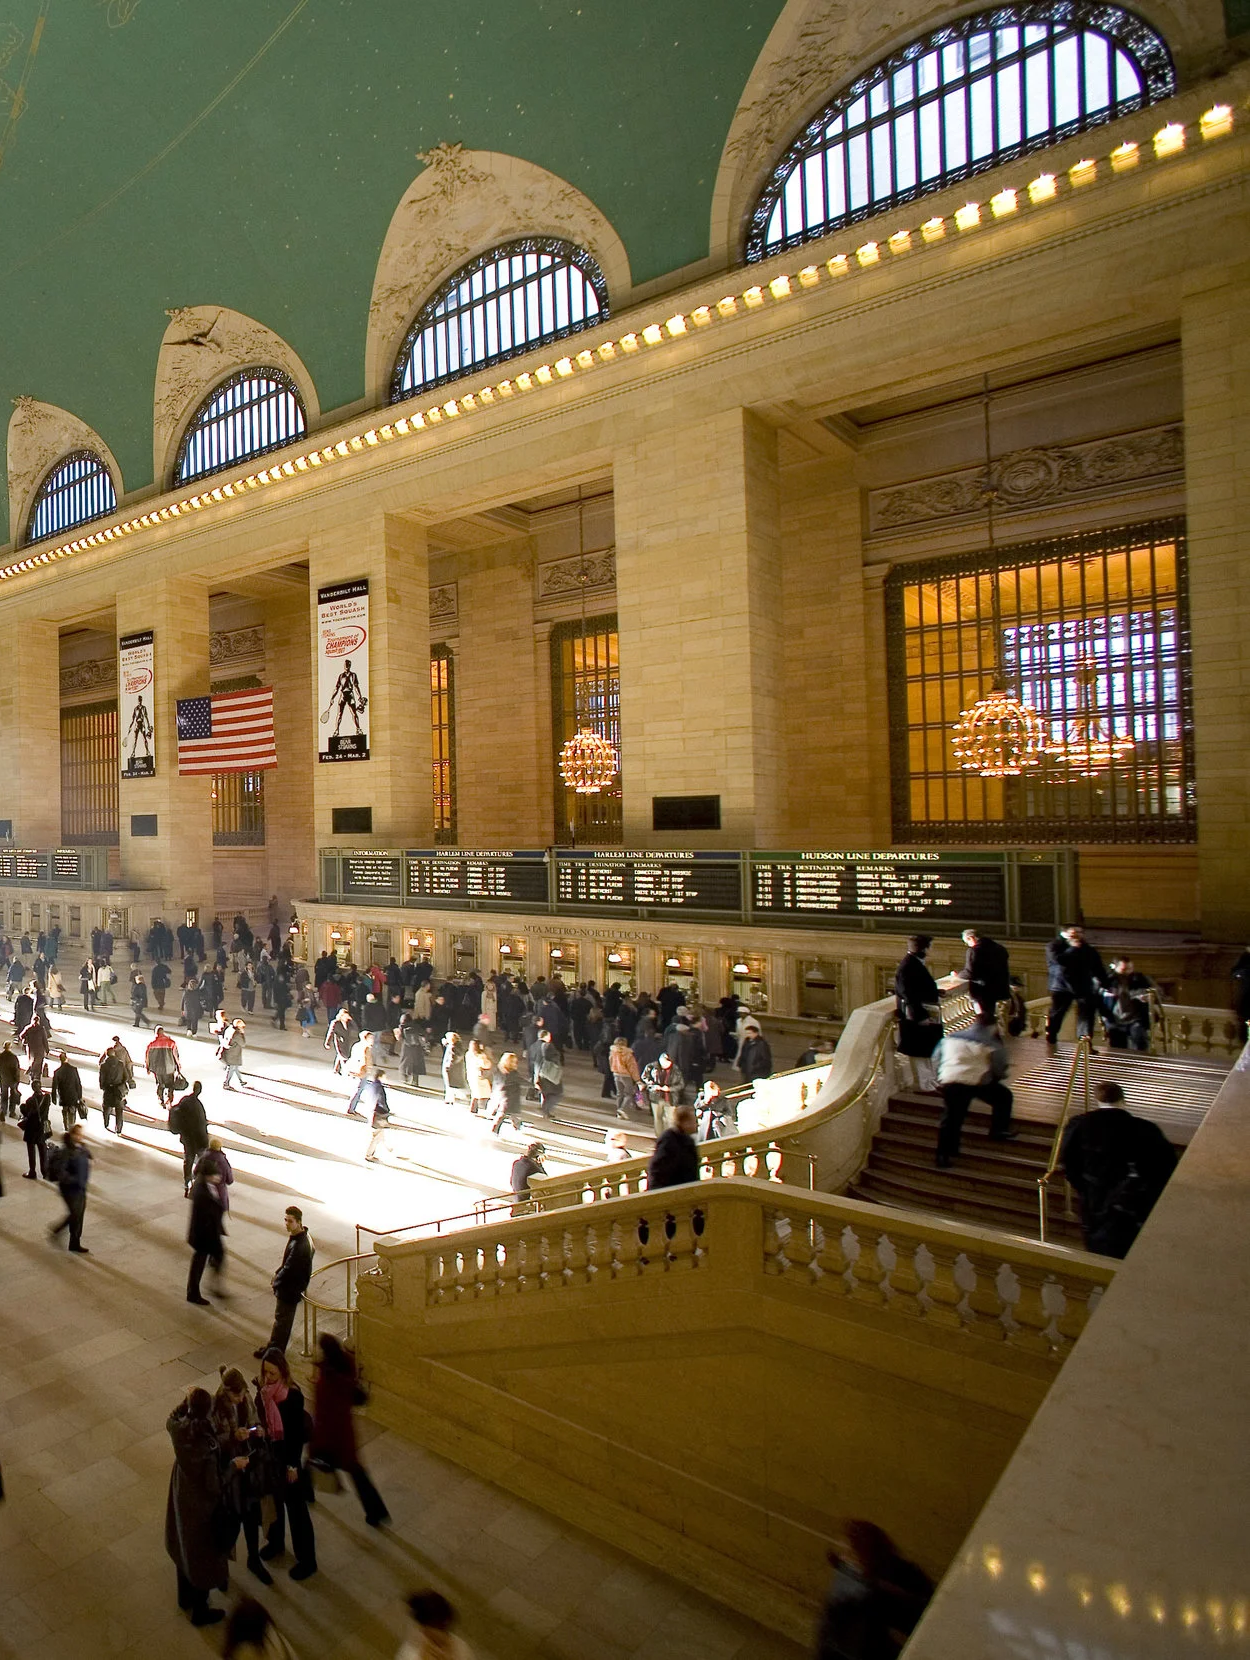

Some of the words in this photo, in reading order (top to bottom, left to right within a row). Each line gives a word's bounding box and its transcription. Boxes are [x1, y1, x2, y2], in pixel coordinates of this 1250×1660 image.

[320, 588, 351, 599] VANDERBILT
[330, 601, 357, 610] WORLD'S
[340, 606, 365, 615] SQUASH
[326, 639, 358, 649] CHAMPIONS
[872, 853, 939, 861] DEPARTURES
[544, 926, 616, 938] METRO-NORTH
[617, 931, 659, 940] TICKETS
